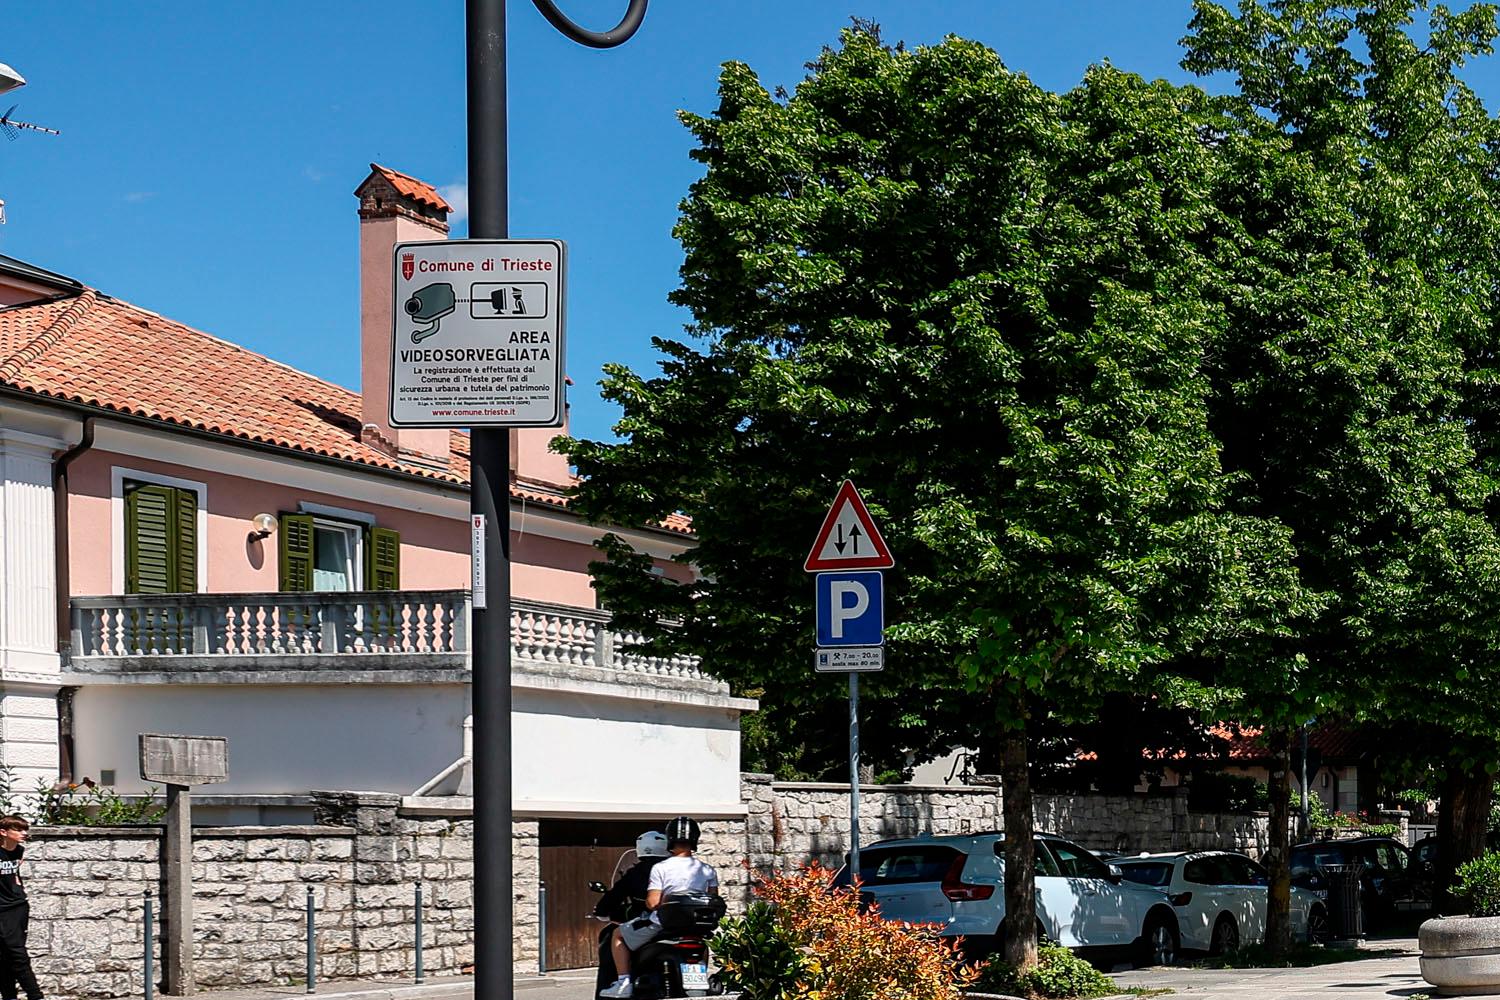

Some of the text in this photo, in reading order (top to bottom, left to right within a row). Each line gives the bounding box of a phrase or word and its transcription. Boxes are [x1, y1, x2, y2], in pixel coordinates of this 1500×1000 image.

[419, 259, 552, 271] Comune di Trieste
[509, 331, 550, 344] AREA
[401, 349, 550, 362] VIDEOSORVEGLIATA
[425, 366, 472, 375] registrazione
[496, 384, 507, 392] del
[510, 384, 550, 392] patrimonio
[432, 408, 516, 416] www.comune.trieste.it
[831, 581, 869, 638] P
